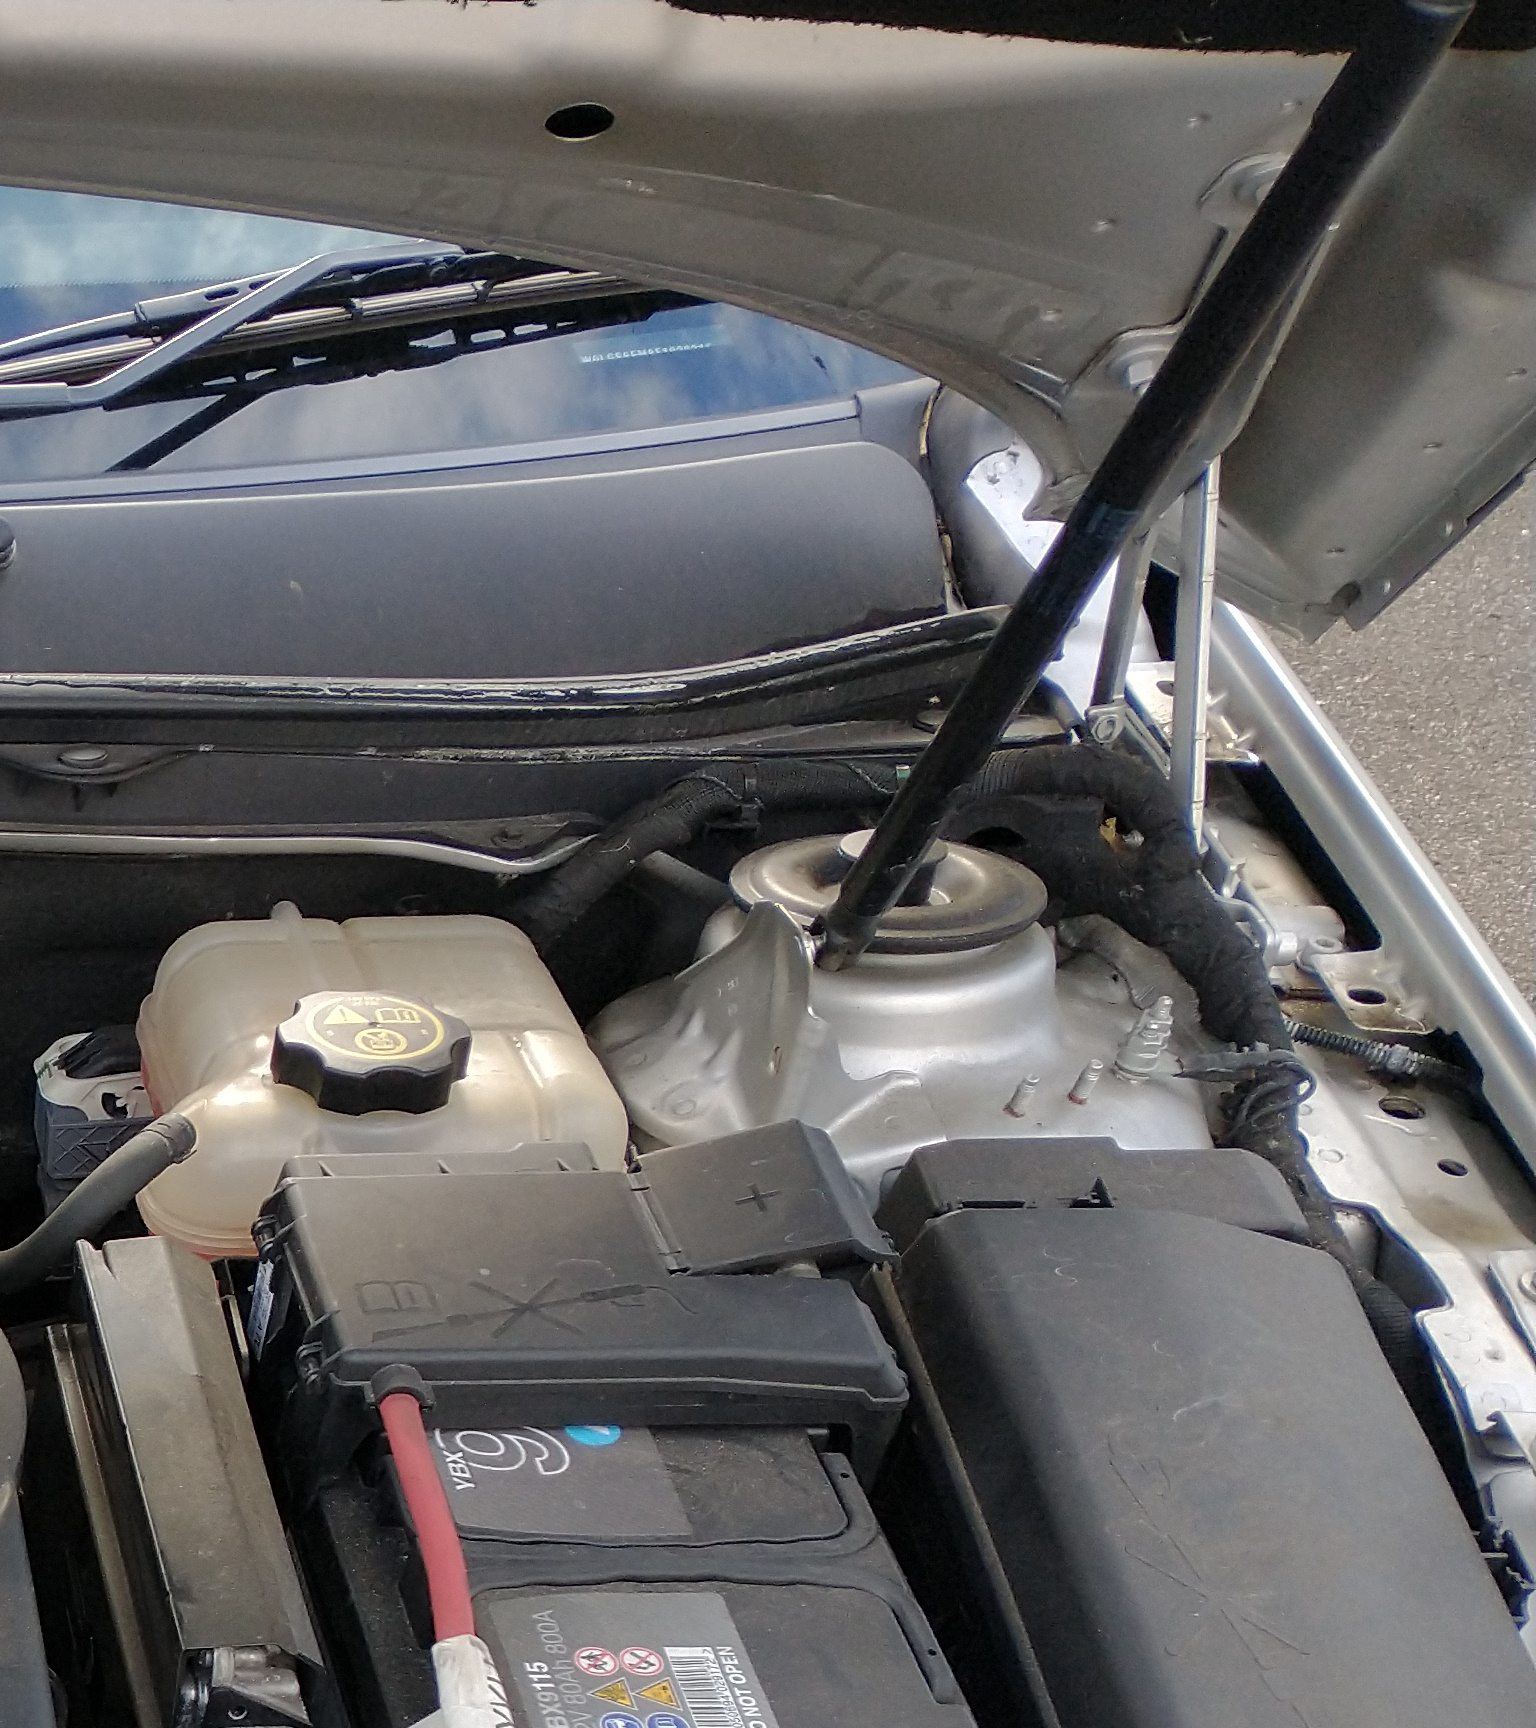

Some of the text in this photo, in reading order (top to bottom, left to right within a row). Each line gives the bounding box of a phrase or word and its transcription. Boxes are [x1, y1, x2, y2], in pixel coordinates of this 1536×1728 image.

[443, 1450, 476, 1490] YBX
[532, 1609, 568, 1655] 800A
[553, 1660, 587, 1706] 80Ah
[716, 1646, 747, 1684] OPEN
[736, 1686, 763, 1717] NOT
